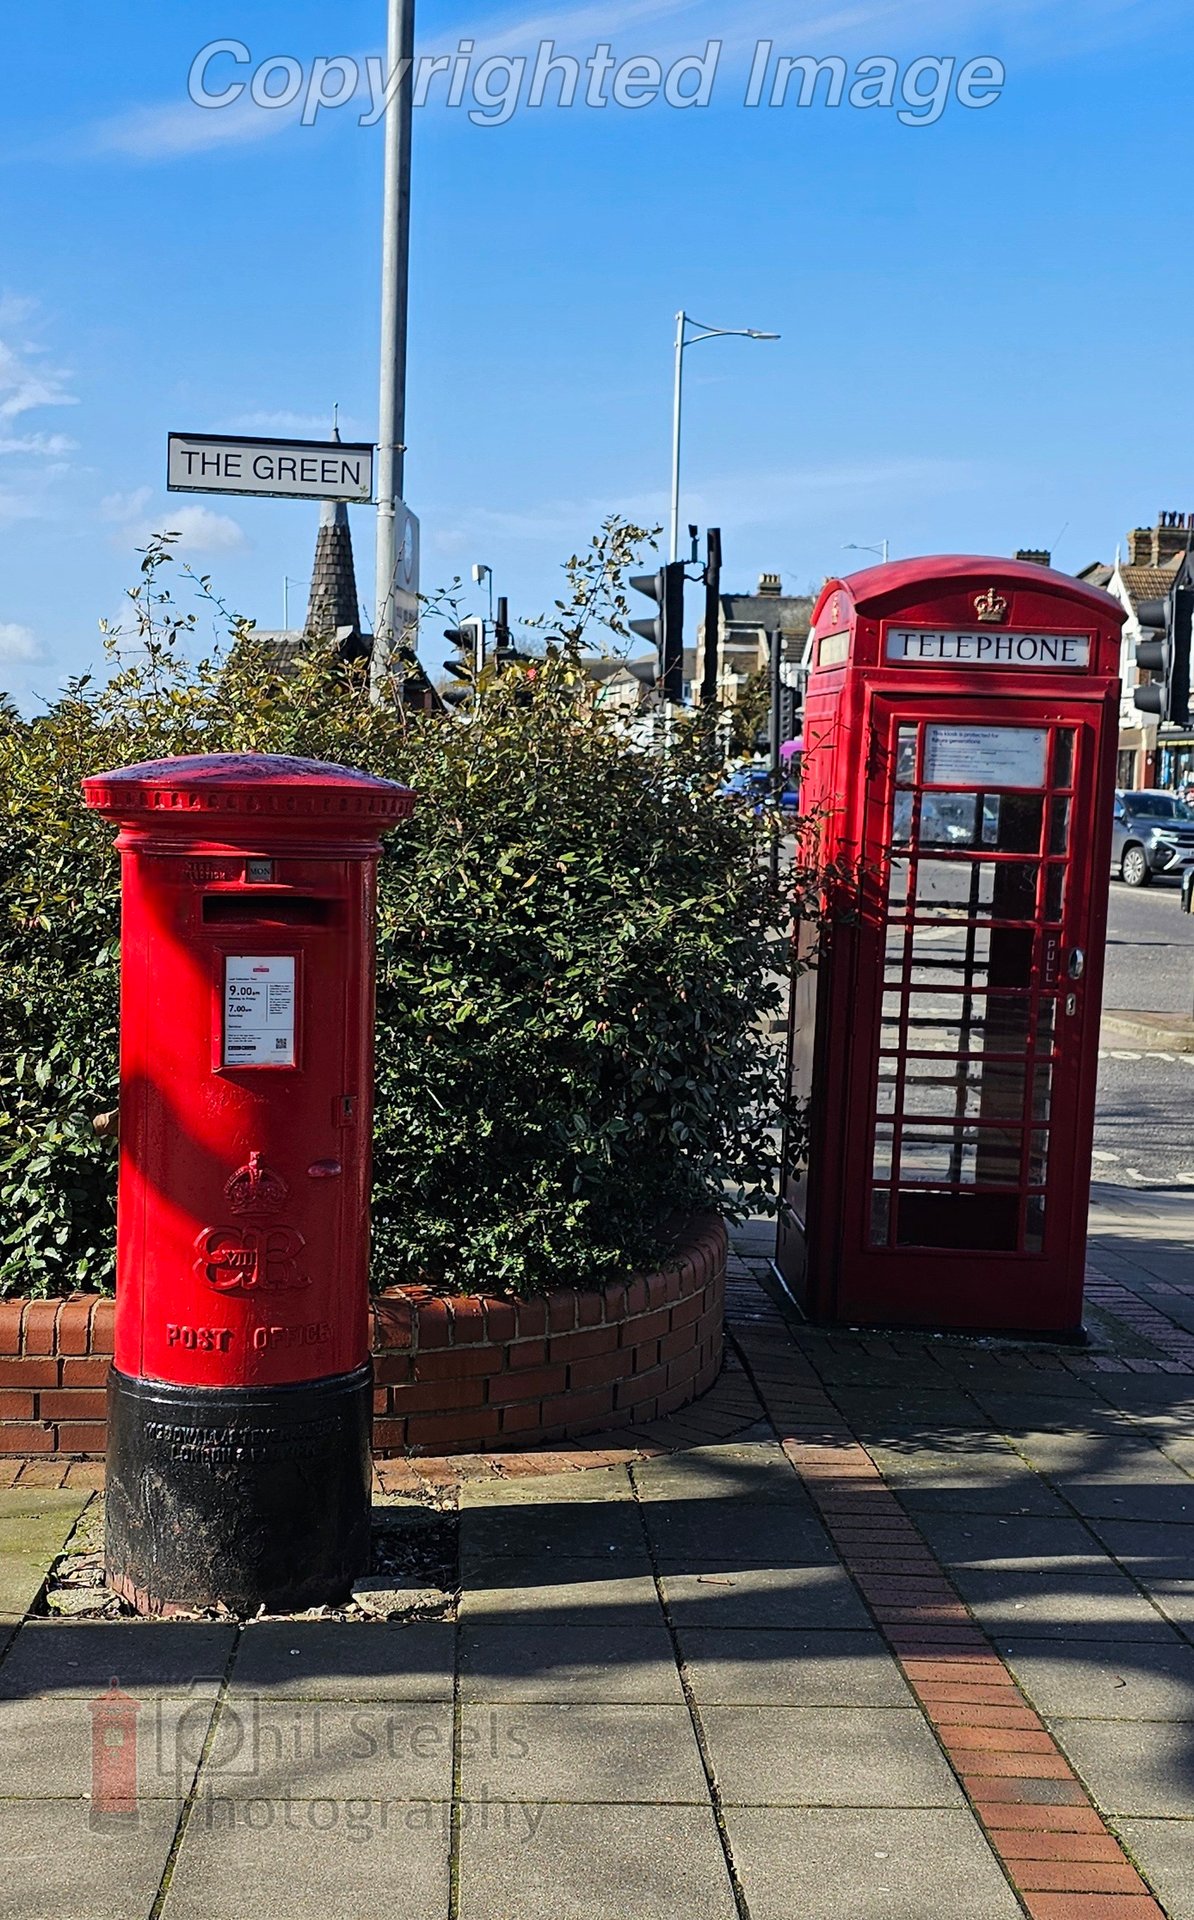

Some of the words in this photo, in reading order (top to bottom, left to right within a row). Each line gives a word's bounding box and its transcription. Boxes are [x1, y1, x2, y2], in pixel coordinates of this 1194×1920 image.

[180, 450, 242, 478] THE
[252, 455, 361, 485] GREEN
[897, 633, 1078, 662] TELEPHONE
[250, 867, 270, 875] MON
[1046, 939, 1056, 983] PULL
[164, 1323, 231, 1352] POST
[253, 1321, 332, 1350] OFFICE
